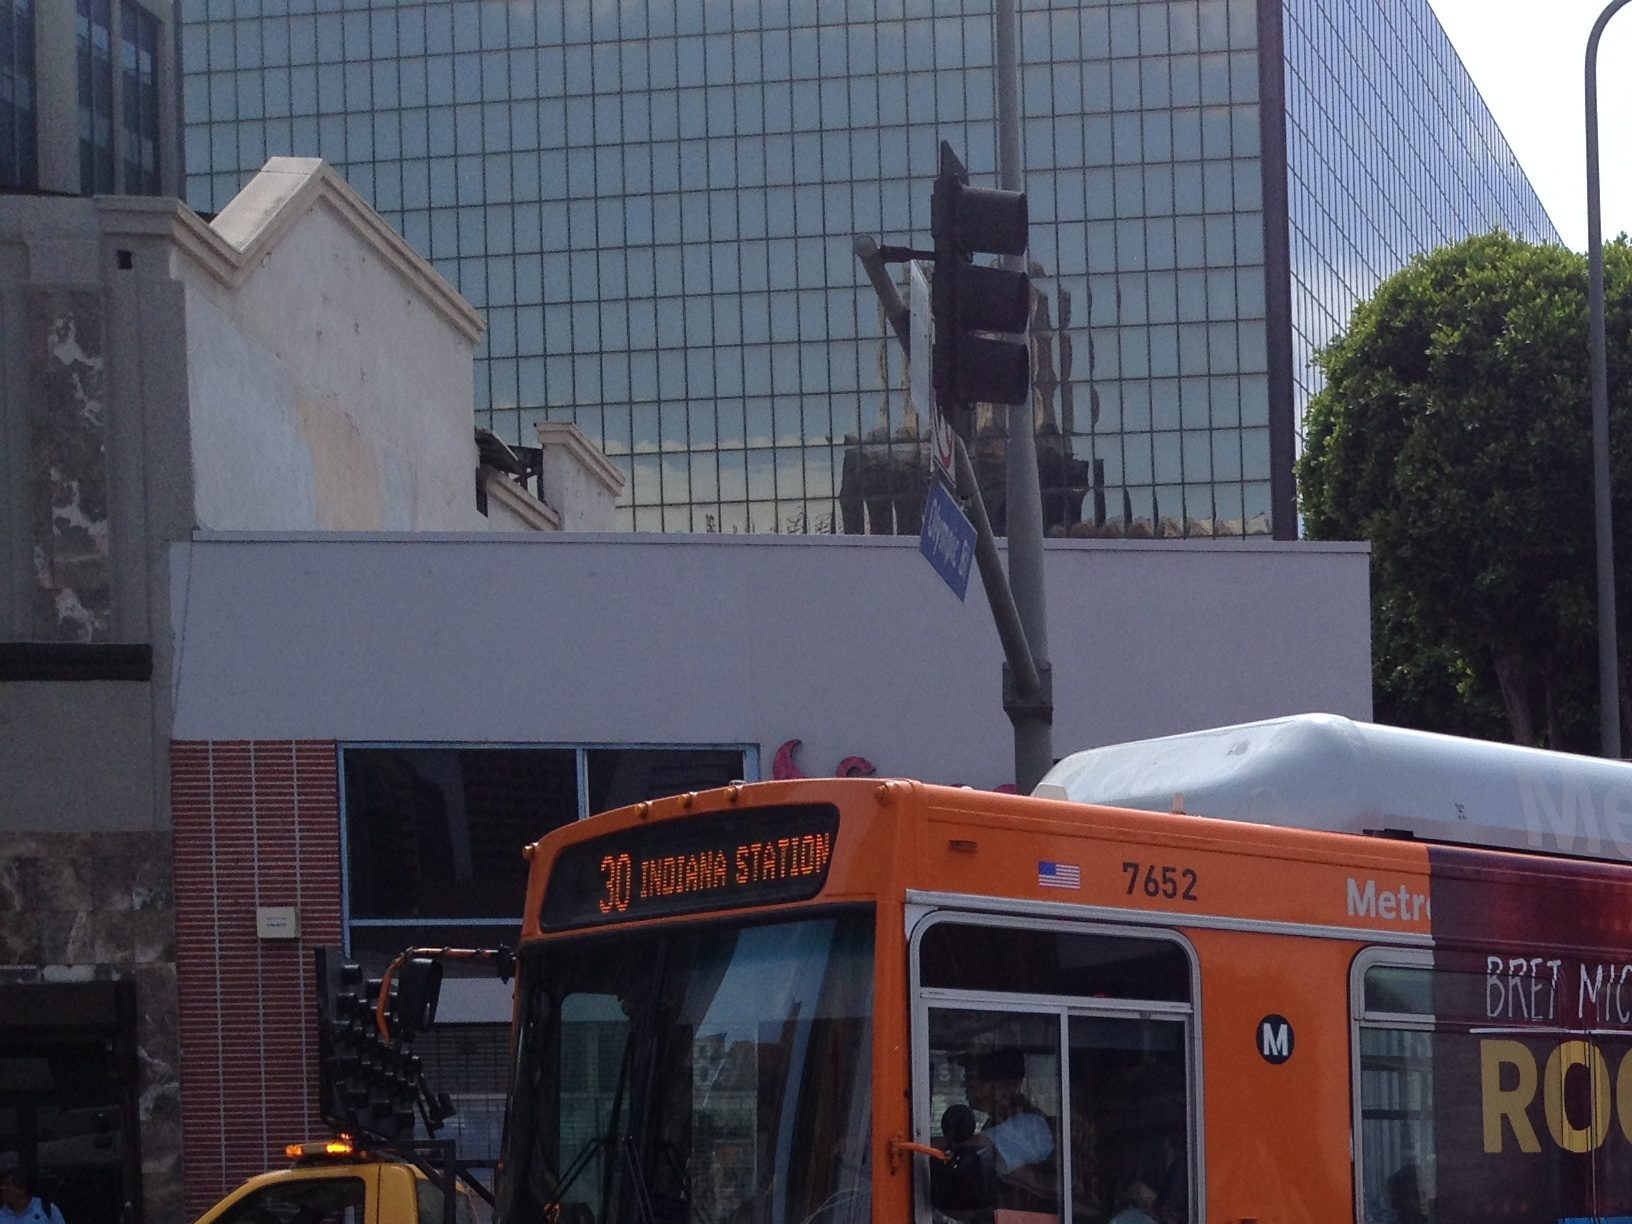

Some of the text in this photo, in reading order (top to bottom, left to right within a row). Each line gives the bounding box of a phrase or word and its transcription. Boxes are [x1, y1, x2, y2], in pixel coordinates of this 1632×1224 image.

[600, 833, 829, 913] 30 INDIANA STATION
[1122, 862, 1198, 901] 7652
[1486, 956, 1562, 1022] BRET
[1263, 1023, 1288, 1056] M
